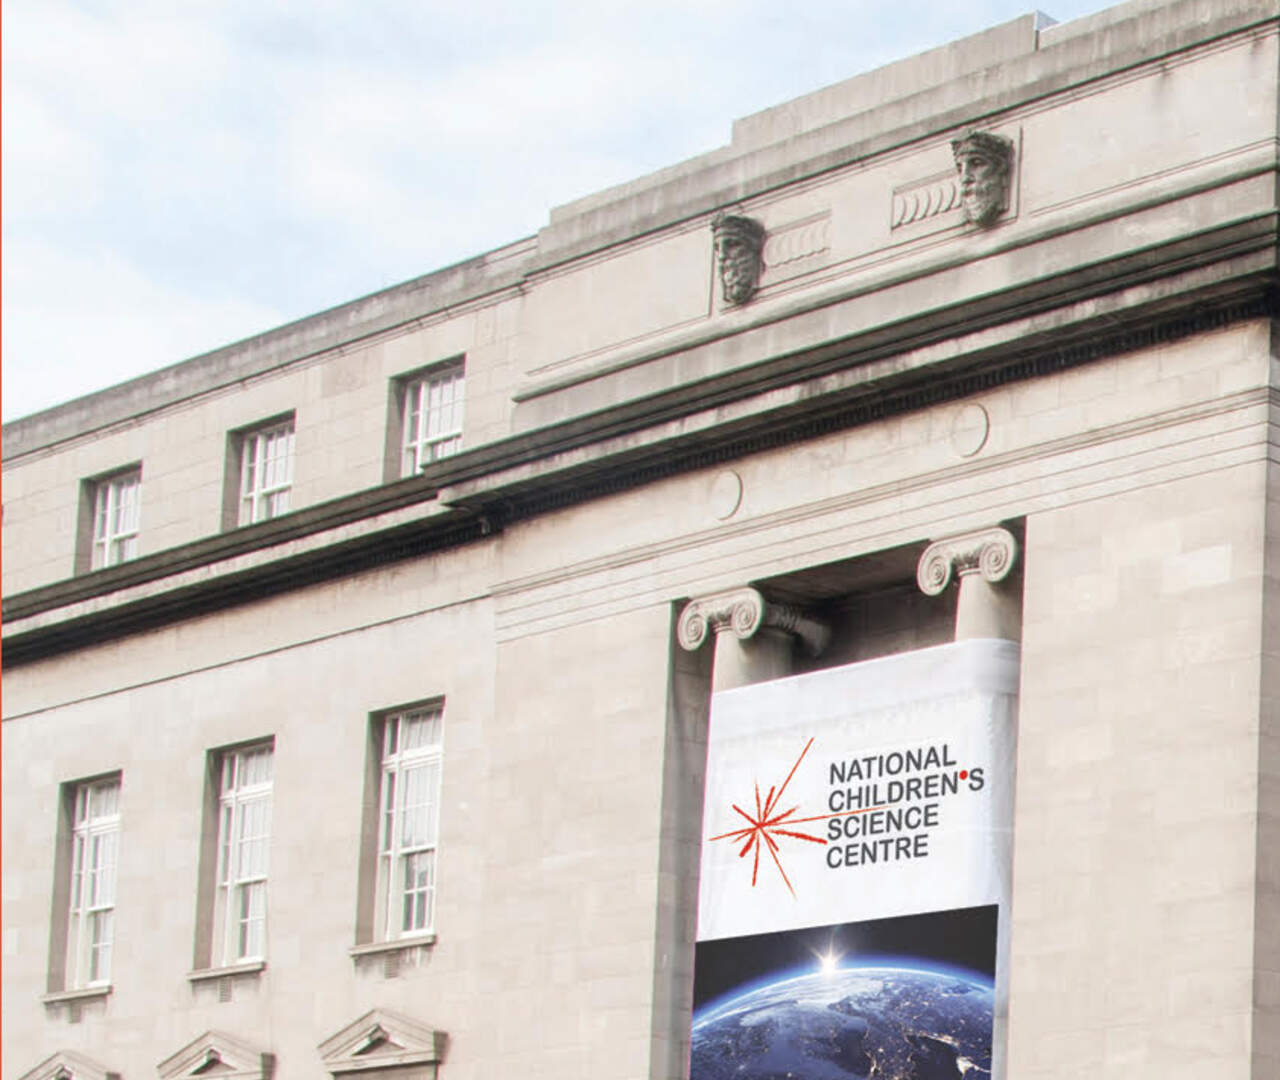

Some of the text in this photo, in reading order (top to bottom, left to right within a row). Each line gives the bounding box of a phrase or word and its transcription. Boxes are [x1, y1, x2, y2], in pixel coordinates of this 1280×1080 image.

[830, 744, 957, 785] NATIONAL
[827, 804, 940, 841] SCIENCE
[826, 834, 930, 869] CENTRE
